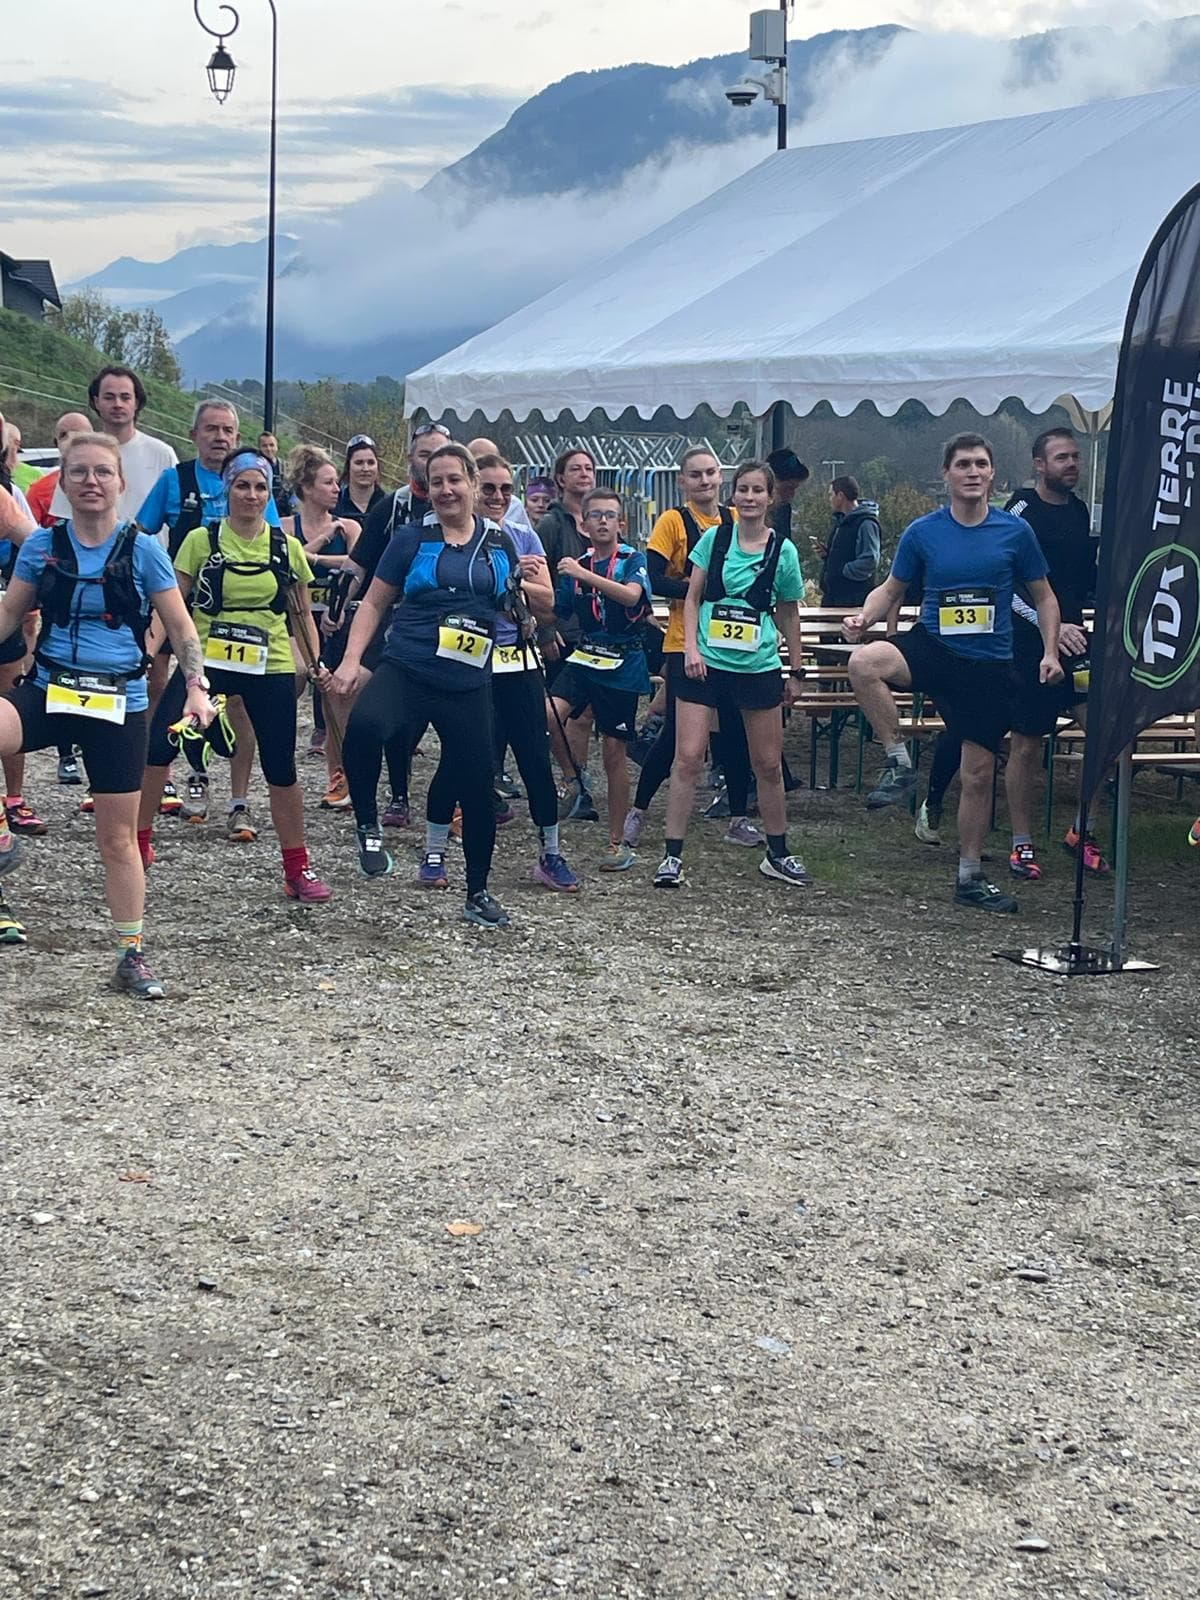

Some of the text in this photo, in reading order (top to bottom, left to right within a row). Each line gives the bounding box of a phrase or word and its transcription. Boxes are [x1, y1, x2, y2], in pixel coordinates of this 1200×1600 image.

[1152, 378, 1194, 531] TERRE
[954, 608, 977, 624] 33
[722, 623, 744, 640] 32
[456, 634, 476, 654] 12
[223, 644, 246, 662] 11
[500, 649, 521, 664] 84
